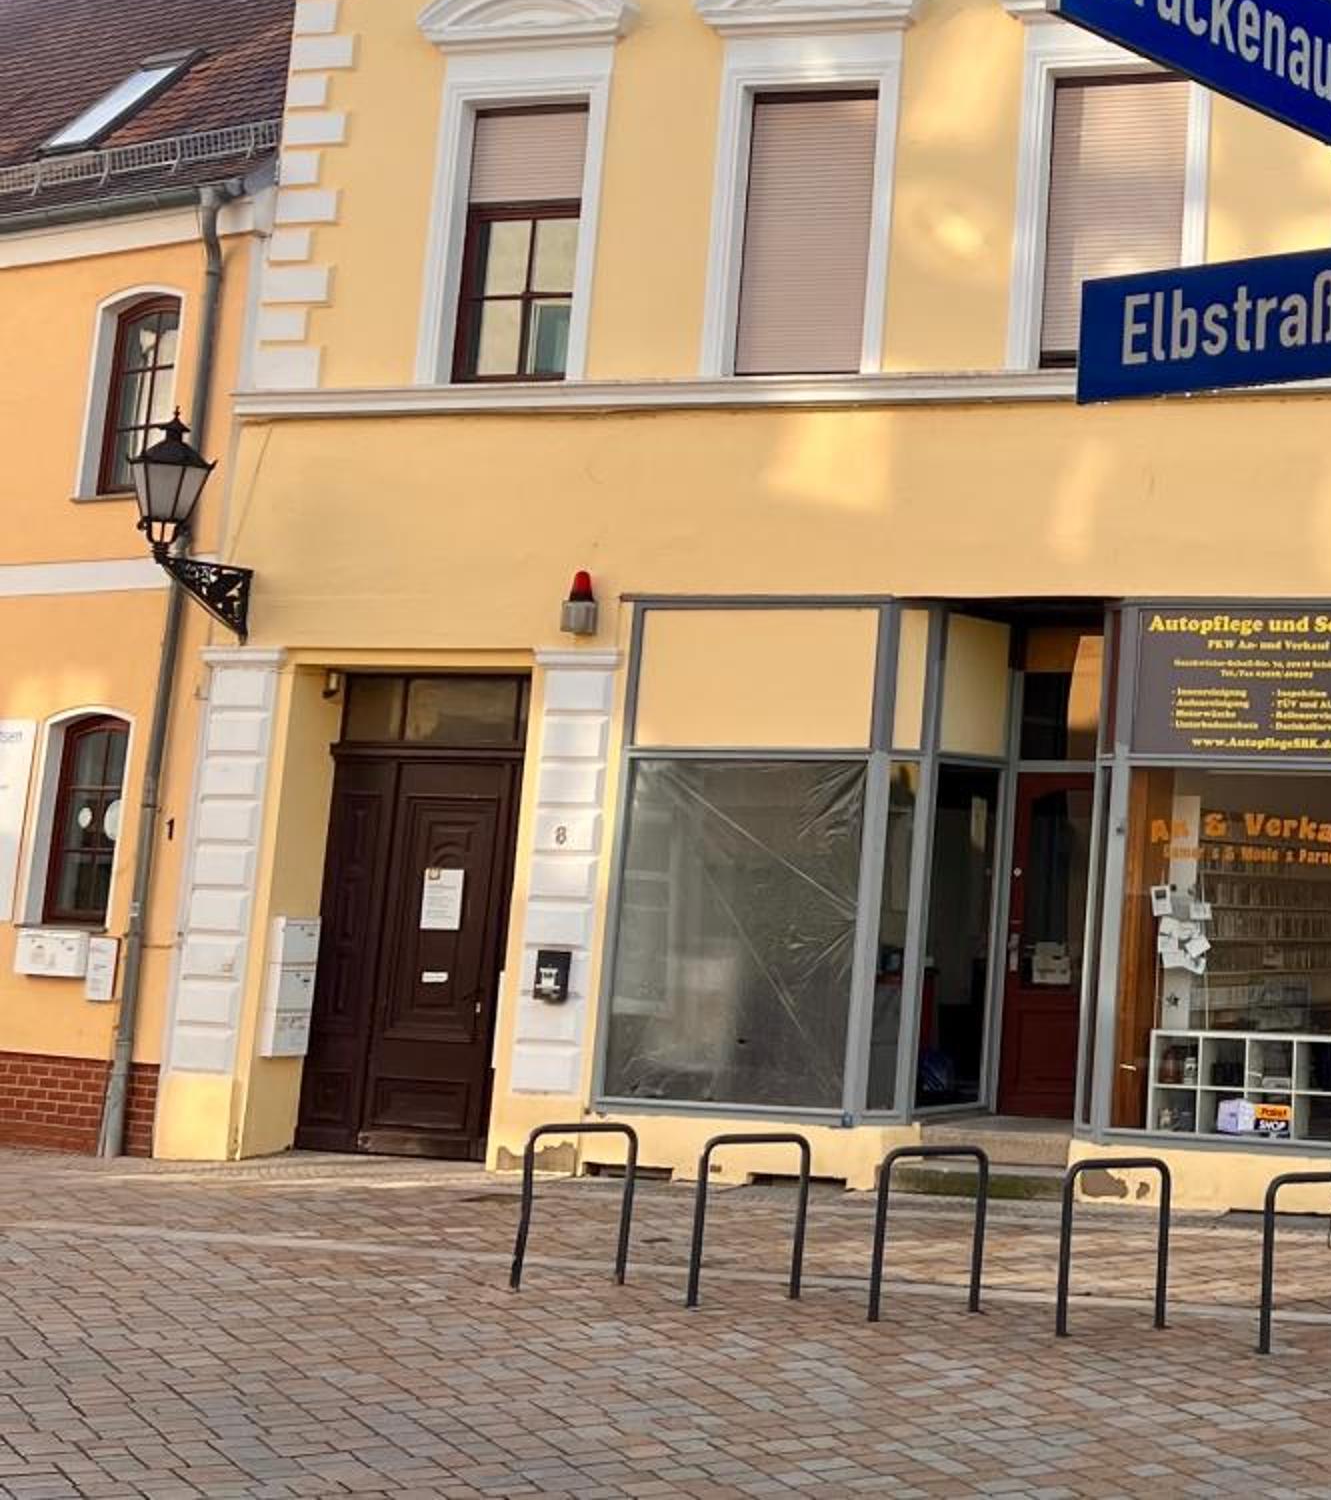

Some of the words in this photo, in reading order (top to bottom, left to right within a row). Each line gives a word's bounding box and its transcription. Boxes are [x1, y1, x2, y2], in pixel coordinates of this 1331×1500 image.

[1148, 614, 1264, 635] Autopflege
[1269, 616, 1310, 633] und
[1260, 640, 1282, 650] und
[1284, 639, 1330, 651] Verkauf
[166, 818, 175, 841] 1
[1204, 812, 1229, 837] &
[555, 825, 567, 845] 8
[1258, 1120, 1286, 1132] SHOP
